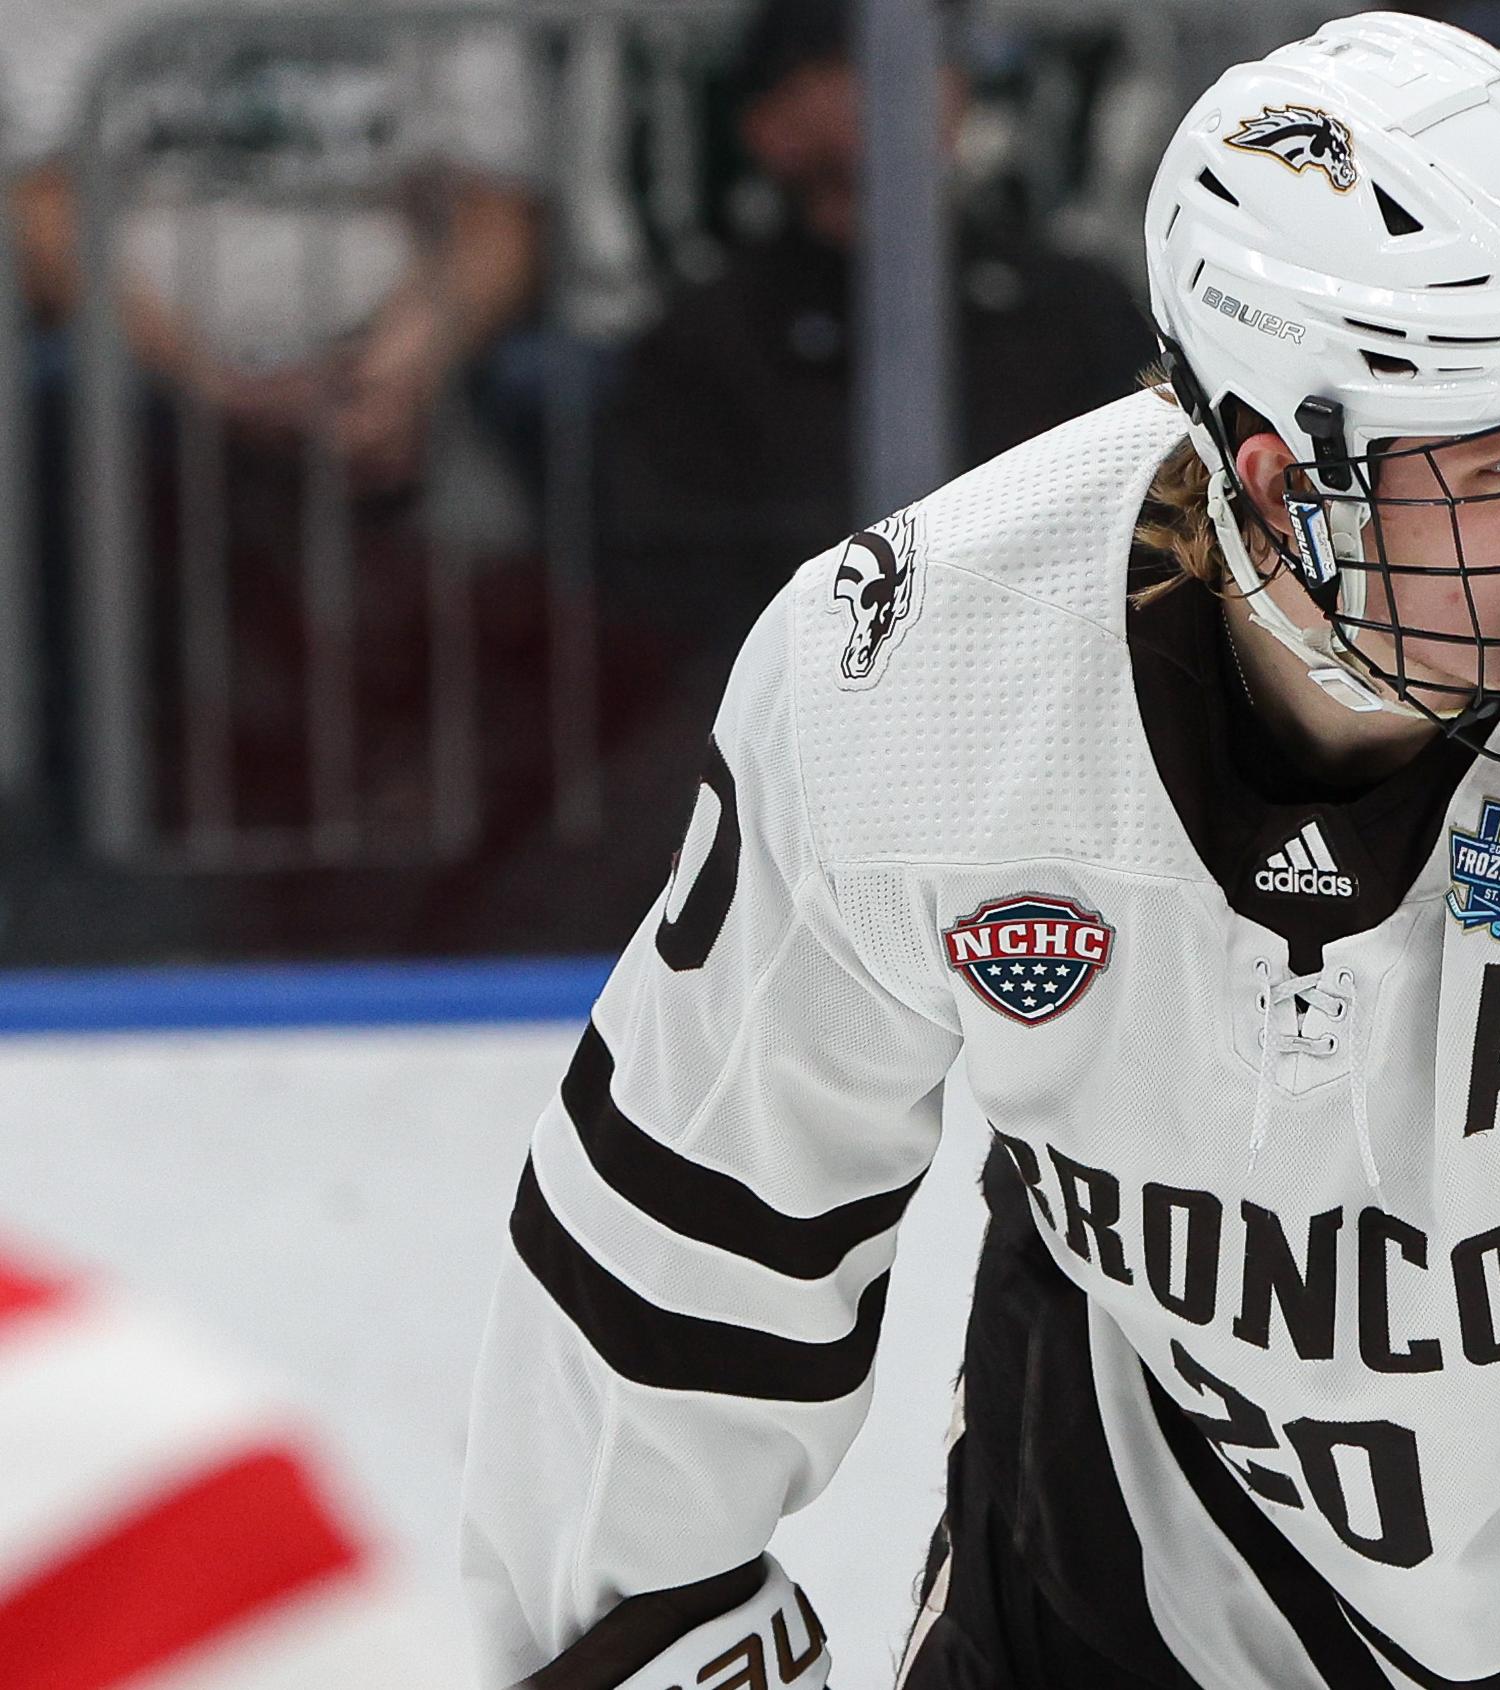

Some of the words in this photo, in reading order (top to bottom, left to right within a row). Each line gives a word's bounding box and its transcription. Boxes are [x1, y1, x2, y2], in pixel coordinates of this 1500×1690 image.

[1256, 867, 1353, 897] adidas
[1484, 888, 1499, 901] ST.
[951, 922, 1104, 960] NCHC
[1170, 1338, 1434, 1569] 20
